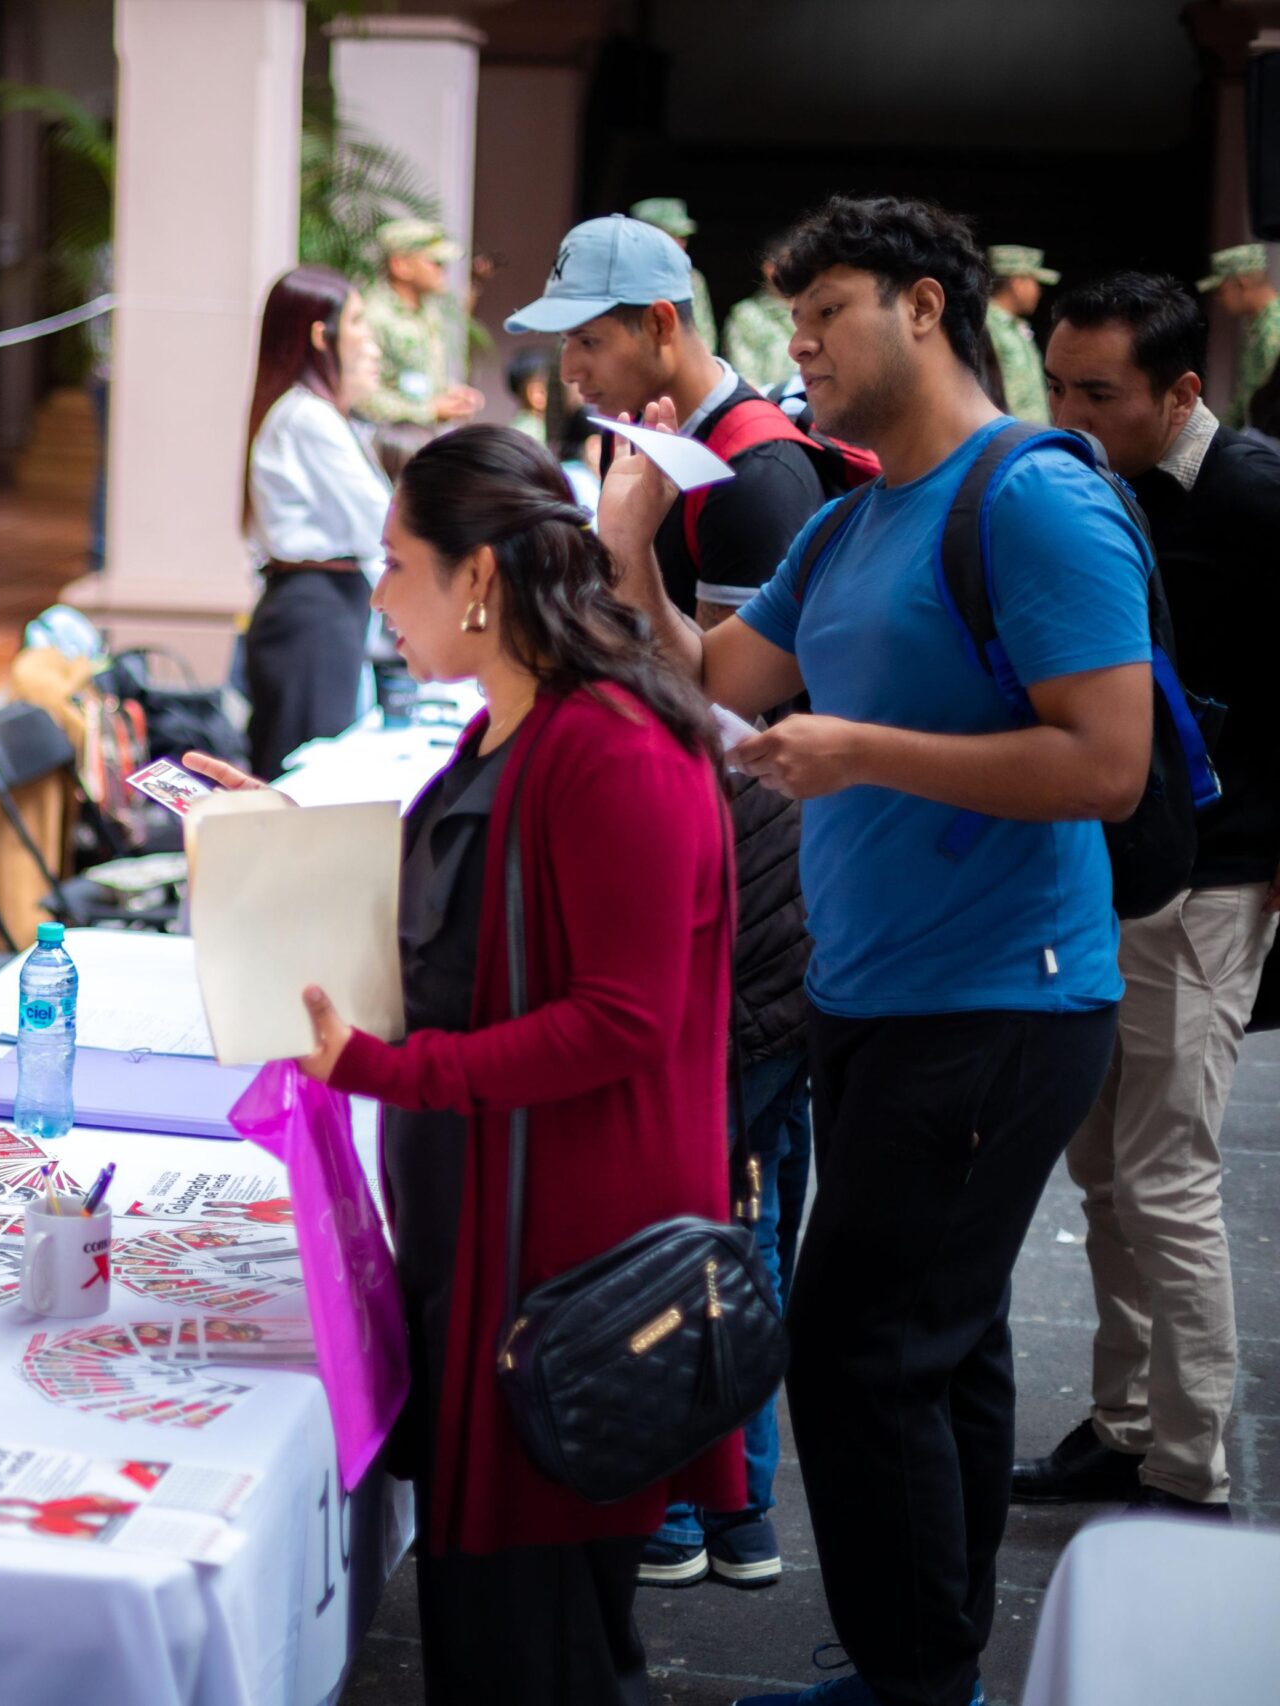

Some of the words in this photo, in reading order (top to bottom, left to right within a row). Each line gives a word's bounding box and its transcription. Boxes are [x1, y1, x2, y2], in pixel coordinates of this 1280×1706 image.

[26, 1005, 52, 1020] ciel
[163, 1172, 214, 1215] Colaborador
[205, 1173, 232, 1195] Tienda
